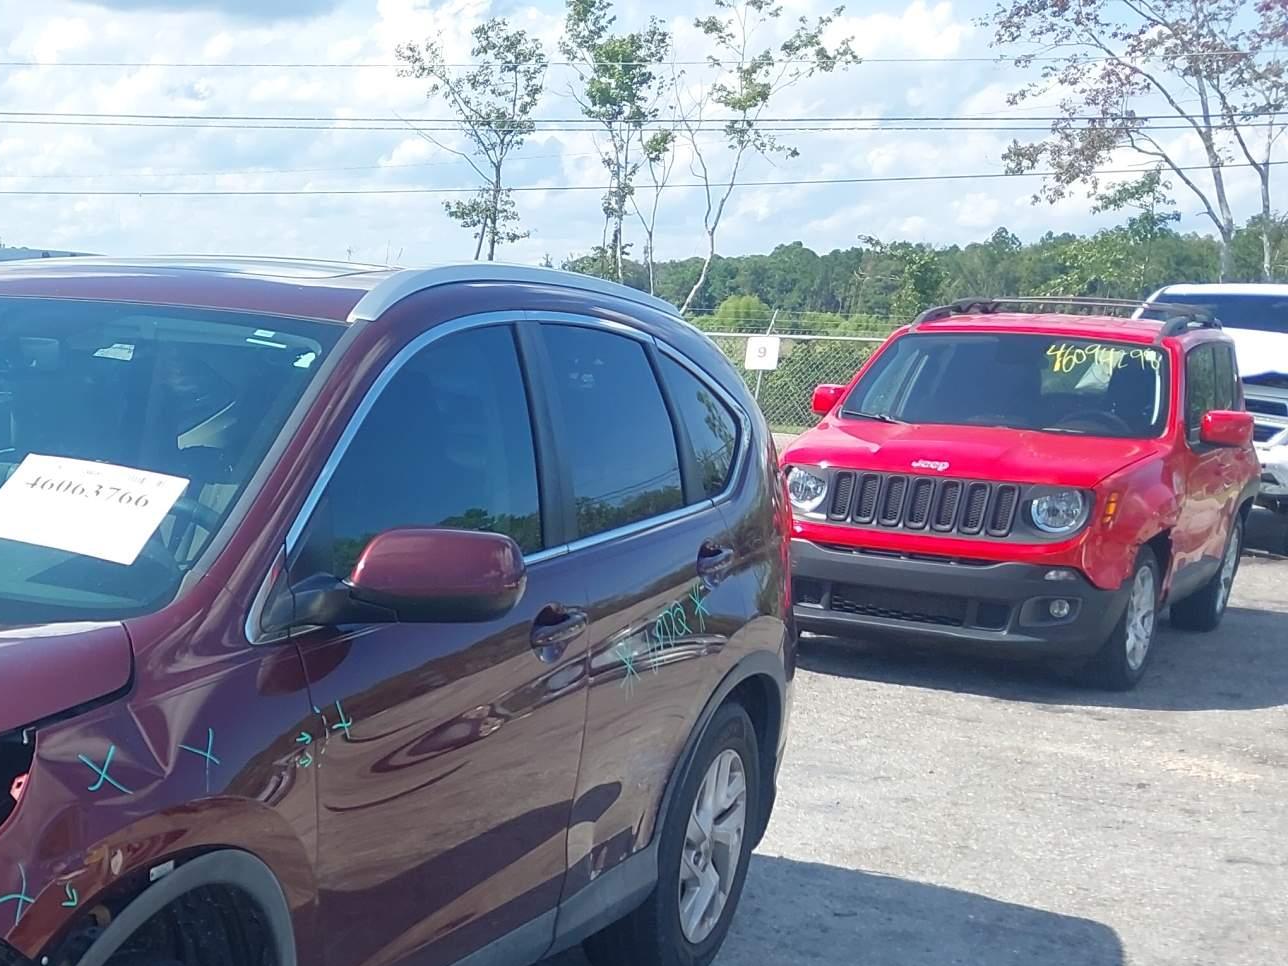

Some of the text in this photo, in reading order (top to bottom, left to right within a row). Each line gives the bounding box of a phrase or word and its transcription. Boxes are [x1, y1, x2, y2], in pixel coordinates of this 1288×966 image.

[757, 346, 768, 359] 9
[911, 459, 950, 472] Jeep
[25, 475, 150, 508] 46063766
